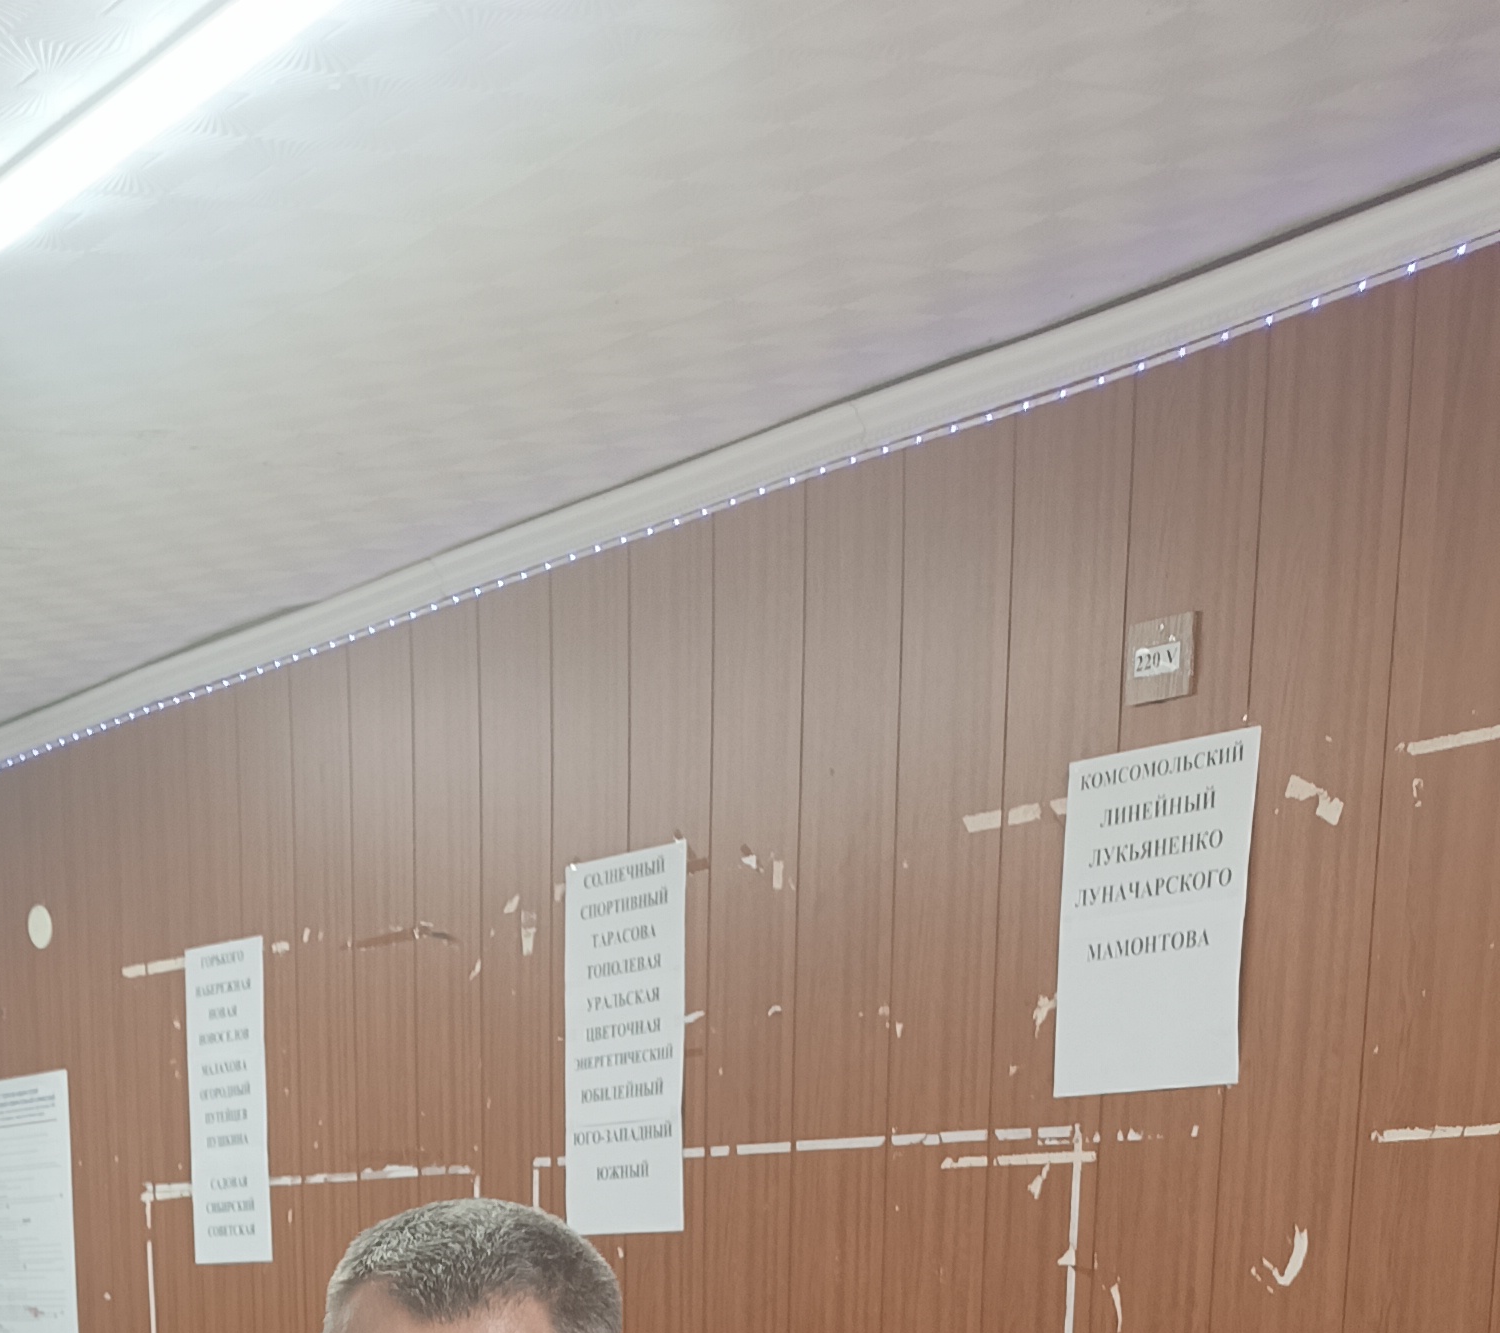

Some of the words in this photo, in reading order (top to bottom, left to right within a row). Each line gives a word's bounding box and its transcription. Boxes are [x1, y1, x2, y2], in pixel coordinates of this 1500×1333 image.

[1136, 651, 1160, 672] 220
[1167, 647, 1178, 664] V
[1079, 740, 1245, 792] КОМСОМОЛЬСКИЙ
[1099, 785, 1216, 828] ЛИНЕЙНЫЙ
[1088, 828, 1224, 869] ЛУКЬЯНЕНКО
[583, 854, 666, 891] СОЛНЕЧНЫЙ
[1074, 867, 1232, 908] ЛУНАЧАРСКОГО
[580, 886, 669, 921] СПОРТИВНЫЙ
[591, 922, 657, 949] ТАРАСОВА
[1086, 928, 1210, 962] МАМОНТОВА
[586, 953, 662, 980] ТОПОЛЕВАЯ
[586, 986, 661, 1013] УРАЛЬСКАЯ
[585, 1017, 662, 1044] ЦВЕТОЧНАЯ
[574, 1044, 674, 1072] ЭНЕРГЕТИЧЕСКИЙ
[580, 1076, 664, 1105] ЮБИЛЕЙНЫЙ
[573, 1120, 673, 1147] ЮГО-ЗАПАДНЫЙ
[596, 1160, 650, 1181] ЮЖНЫЙ
